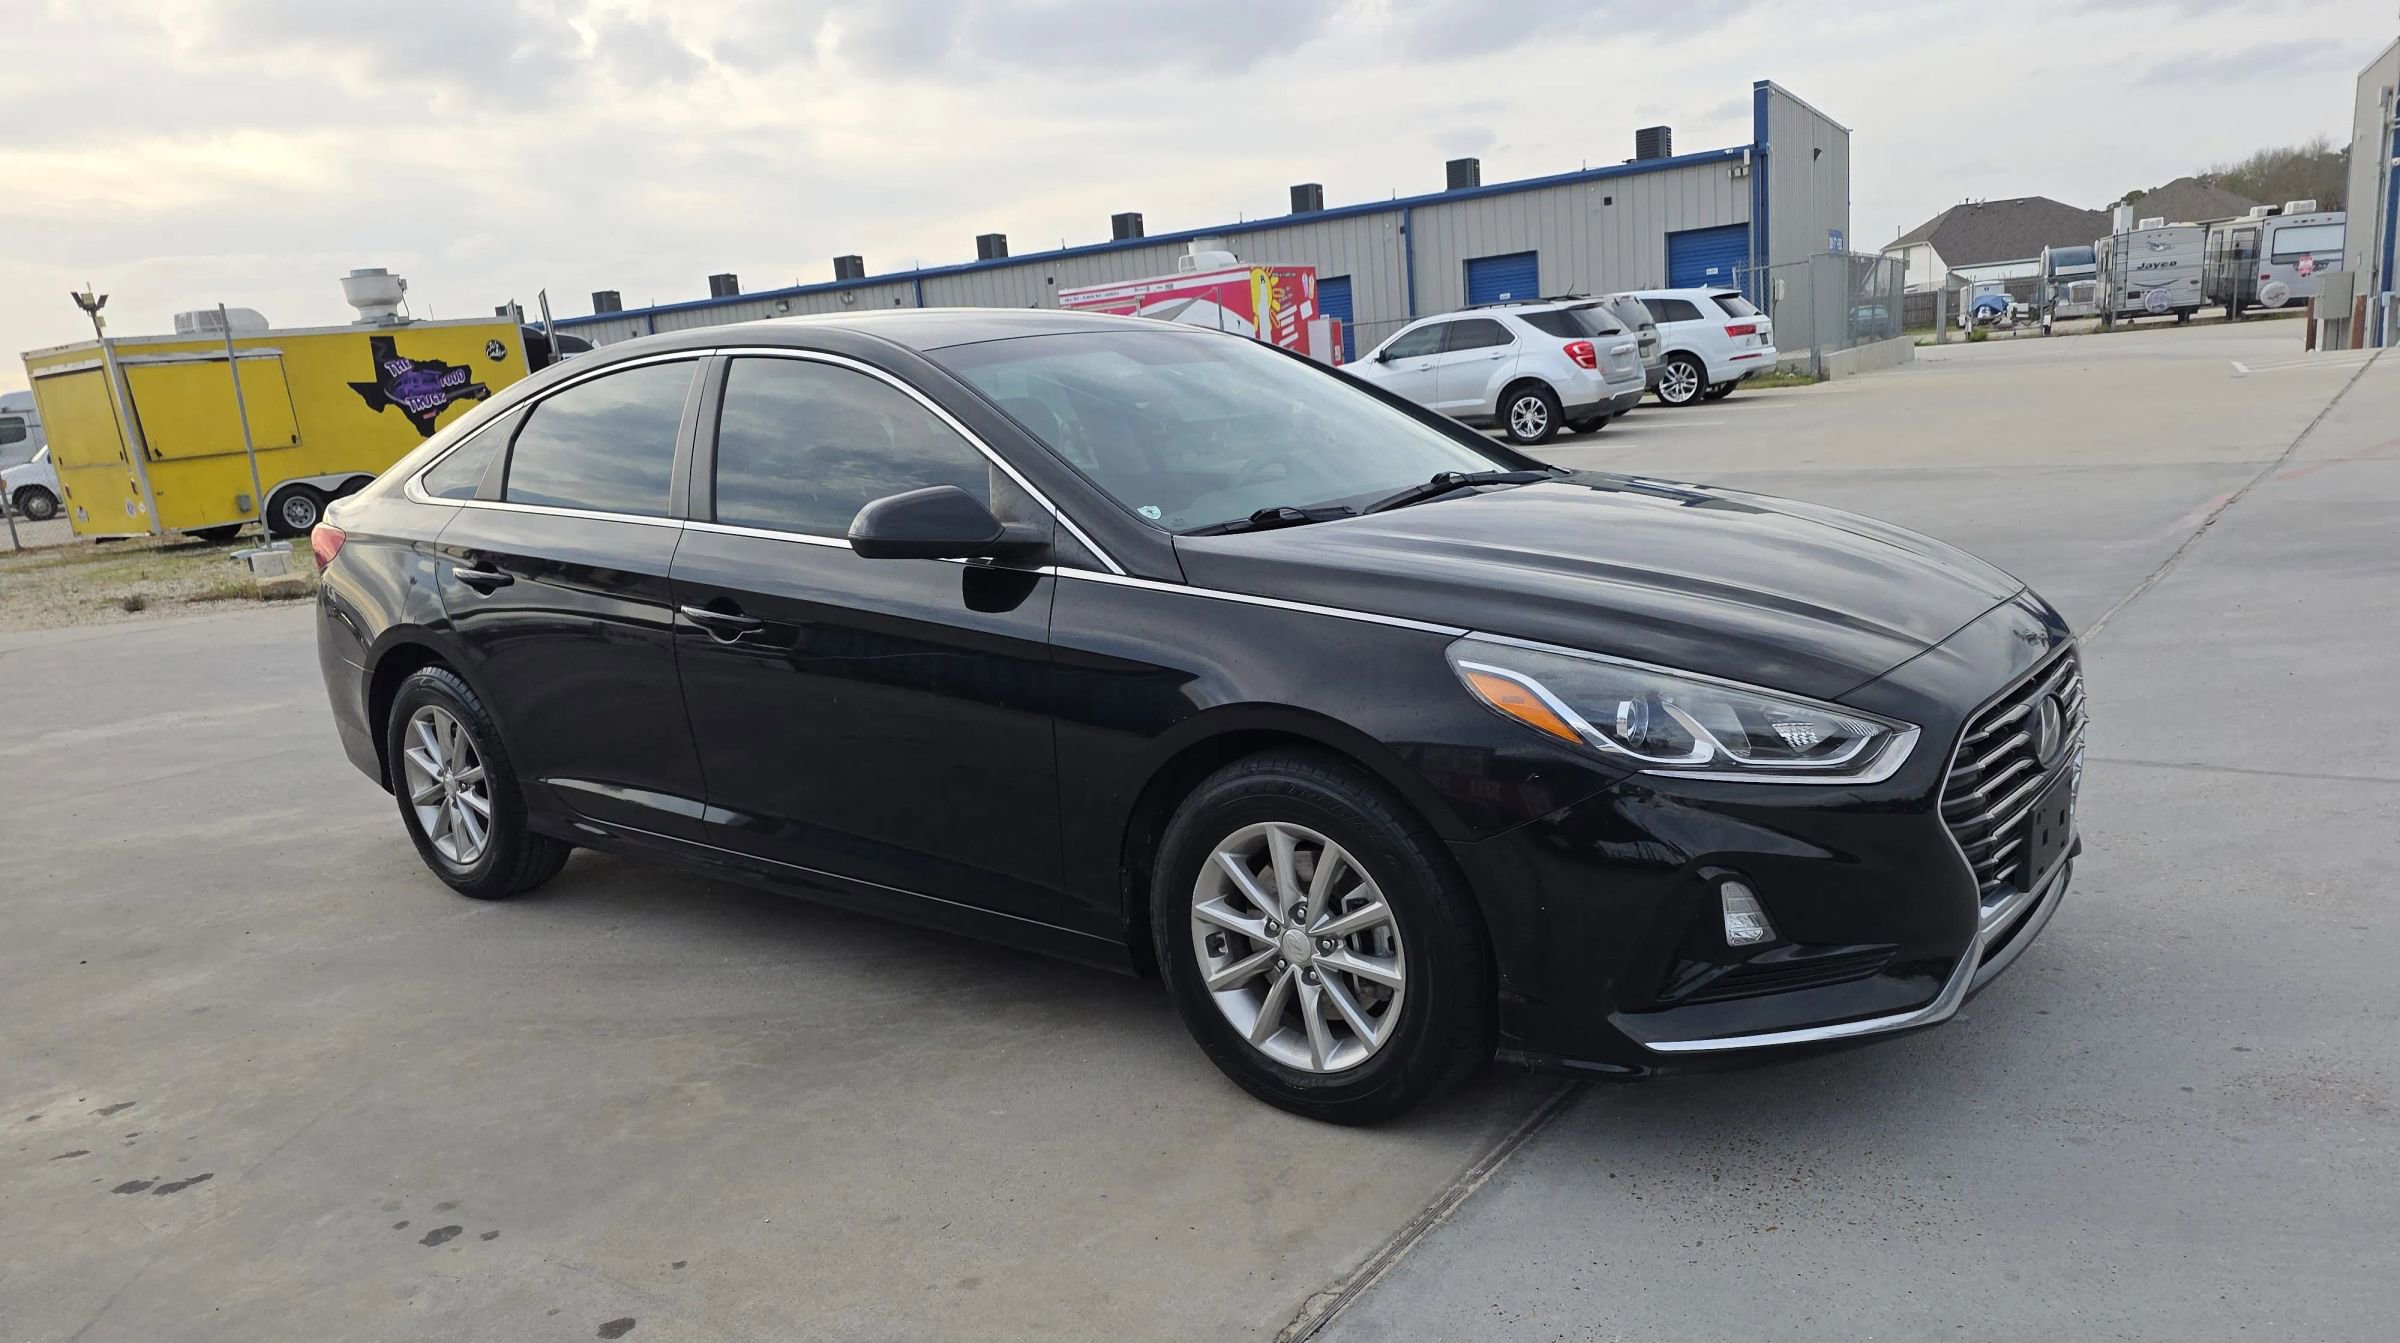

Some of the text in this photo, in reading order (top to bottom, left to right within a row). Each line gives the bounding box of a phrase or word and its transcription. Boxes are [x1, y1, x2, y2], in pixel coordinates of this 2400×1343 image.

[2137, 260, 2178, 271] Jayco
[384, 359, 412, 377] THE
[440, 369, 466, 387] FOOD
[405, 393, 447, 413] TRUCK
